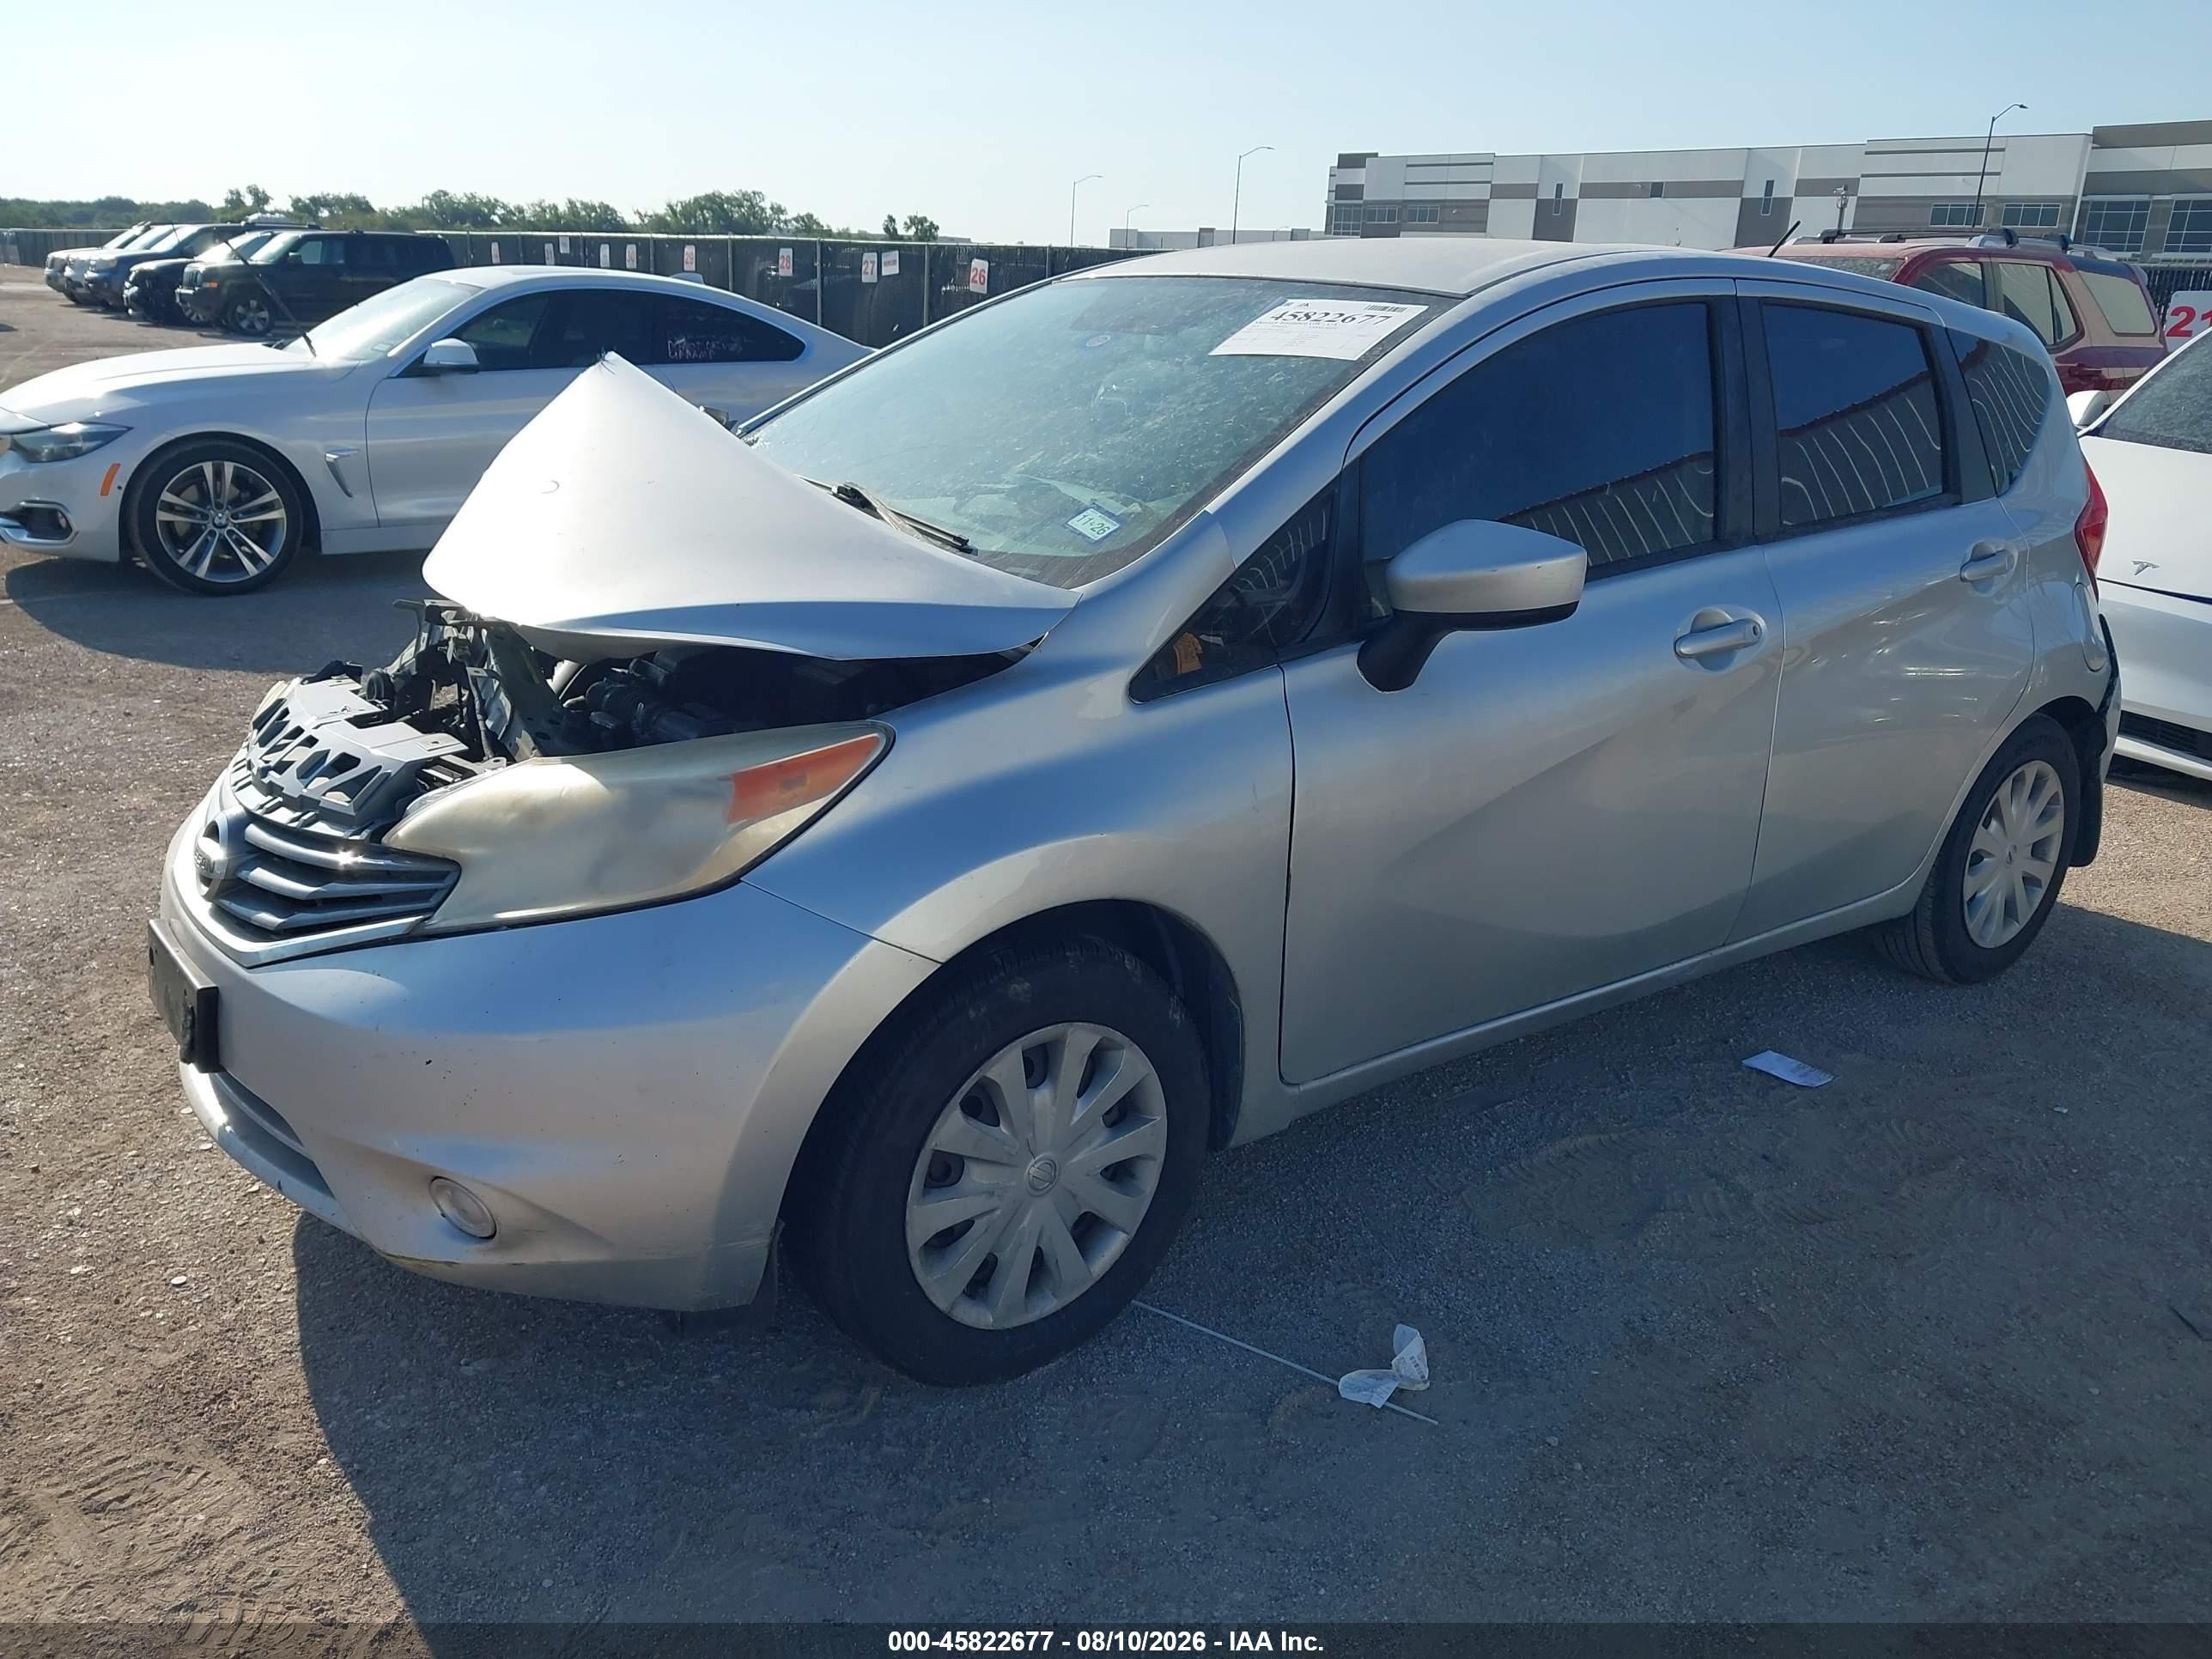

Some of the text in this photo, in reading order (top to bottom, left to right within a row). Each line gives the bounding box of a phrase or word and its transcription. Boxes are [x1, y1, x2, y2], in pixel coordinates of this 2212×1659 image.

[780, 255, 791, 270] 28
[862, 261, 875, 276] 27
[970, 267, 986, 285] 26
[1270, 311, 1394, 325] 45822677
